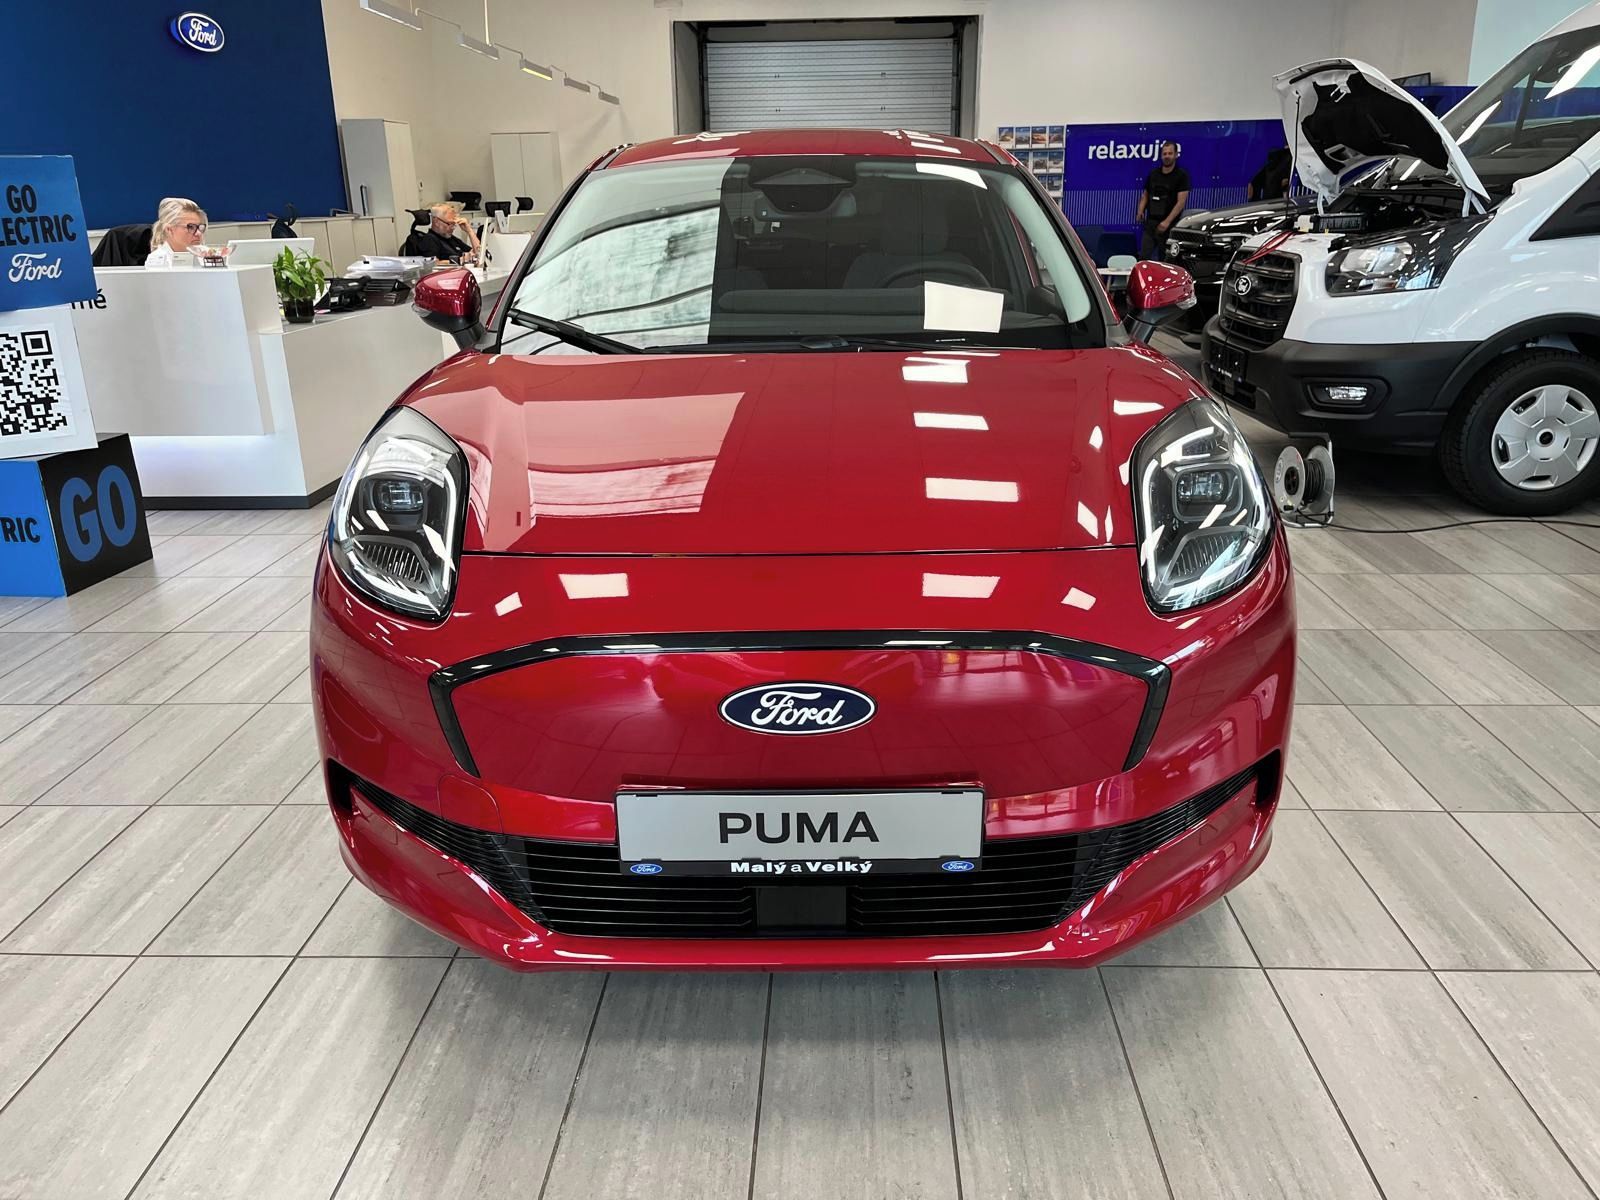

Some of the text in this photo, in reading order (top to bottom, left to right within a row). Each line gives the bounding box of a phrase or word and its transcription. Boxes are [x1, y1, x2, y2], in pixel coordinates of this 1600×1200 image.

[189, 18, 217, 46] Ford
[1088, 139, 1182, 161] relaxuj
[6, 184, 37, 214] GO
[0, 214, 77, 246] ECTRIC
[8, 253, 62, 282] Ford
[60, 464, 137, 562] GO
[751, 691, 845, 726] Ford
[718, 811, 880, 843] PUMA
[731, 860, 873, 874] Malý a Velký
